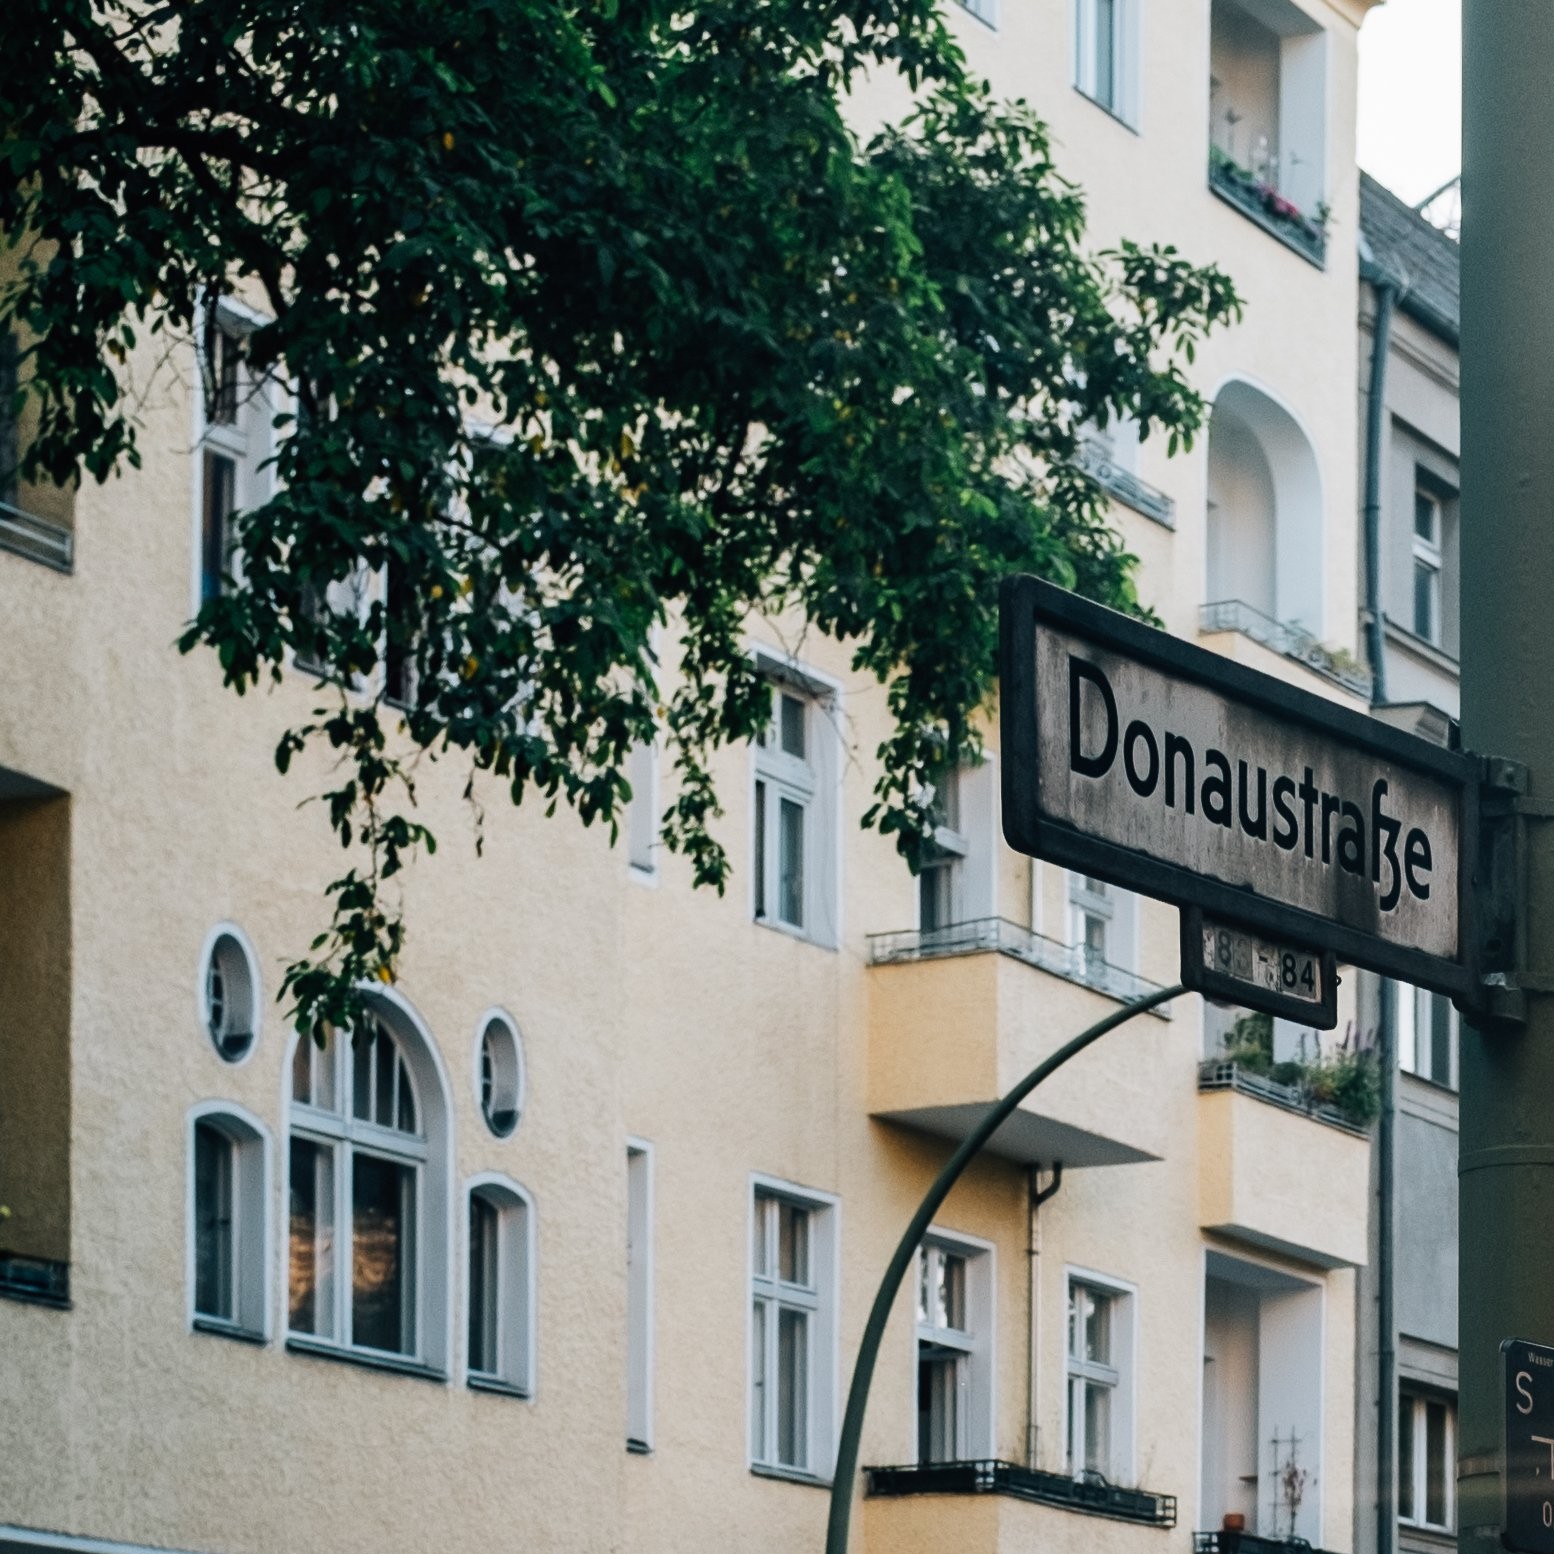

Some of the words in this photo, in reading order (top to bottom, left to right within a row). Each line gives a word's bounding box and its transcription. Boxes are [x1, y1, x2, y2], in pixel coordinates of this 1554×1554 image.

[1069, 655, 1433, 912] Donaustraße
[1282, 953, 1315, 992] 84
[1527, 1352, 1554, 1368] Wasser
[1515, 1371, 1533, 1415] S
